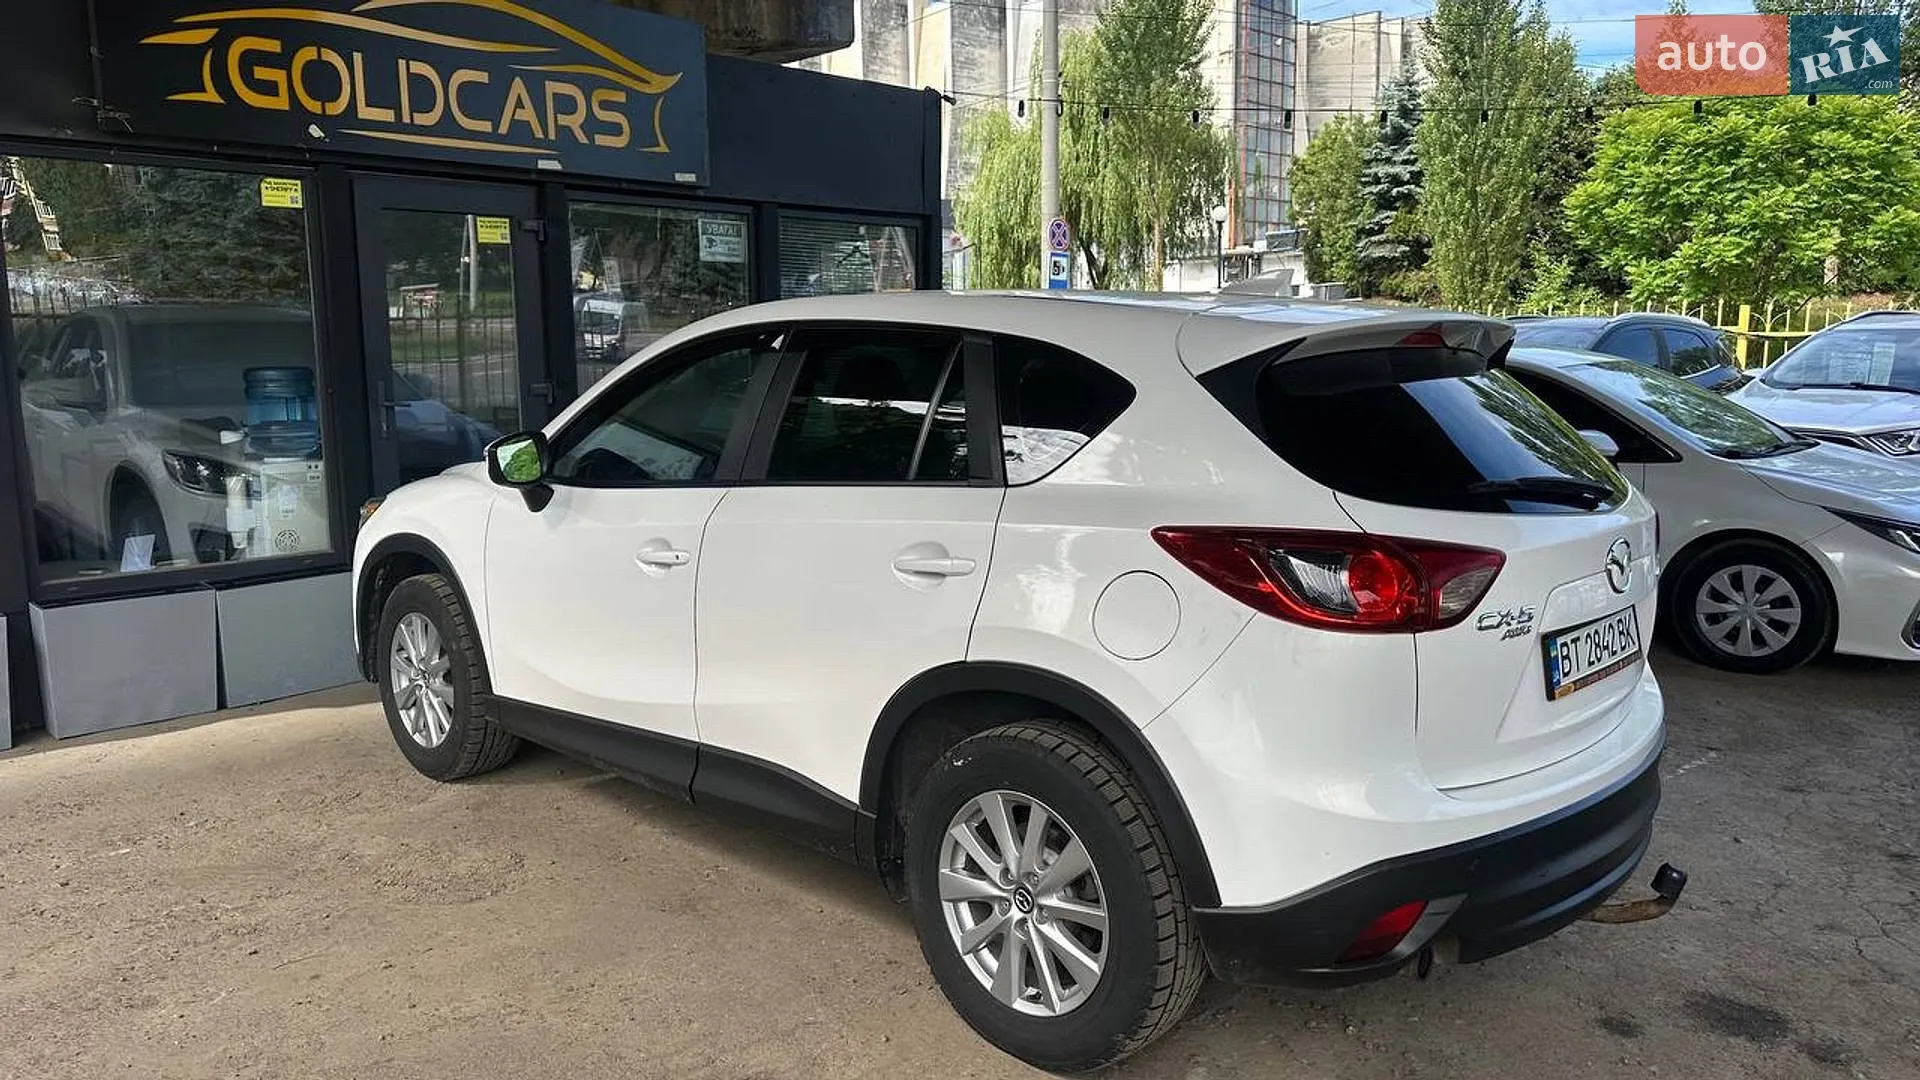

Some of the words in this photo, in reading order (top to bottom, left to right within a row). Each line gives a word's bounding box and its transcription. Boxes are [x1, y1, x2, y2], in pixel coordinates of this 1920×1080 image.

[226, 36, 632, 149] GOLDCARS
[1477, 606, 1536, 631] CX-5
[1585, 624, 1617, 668] 2842
